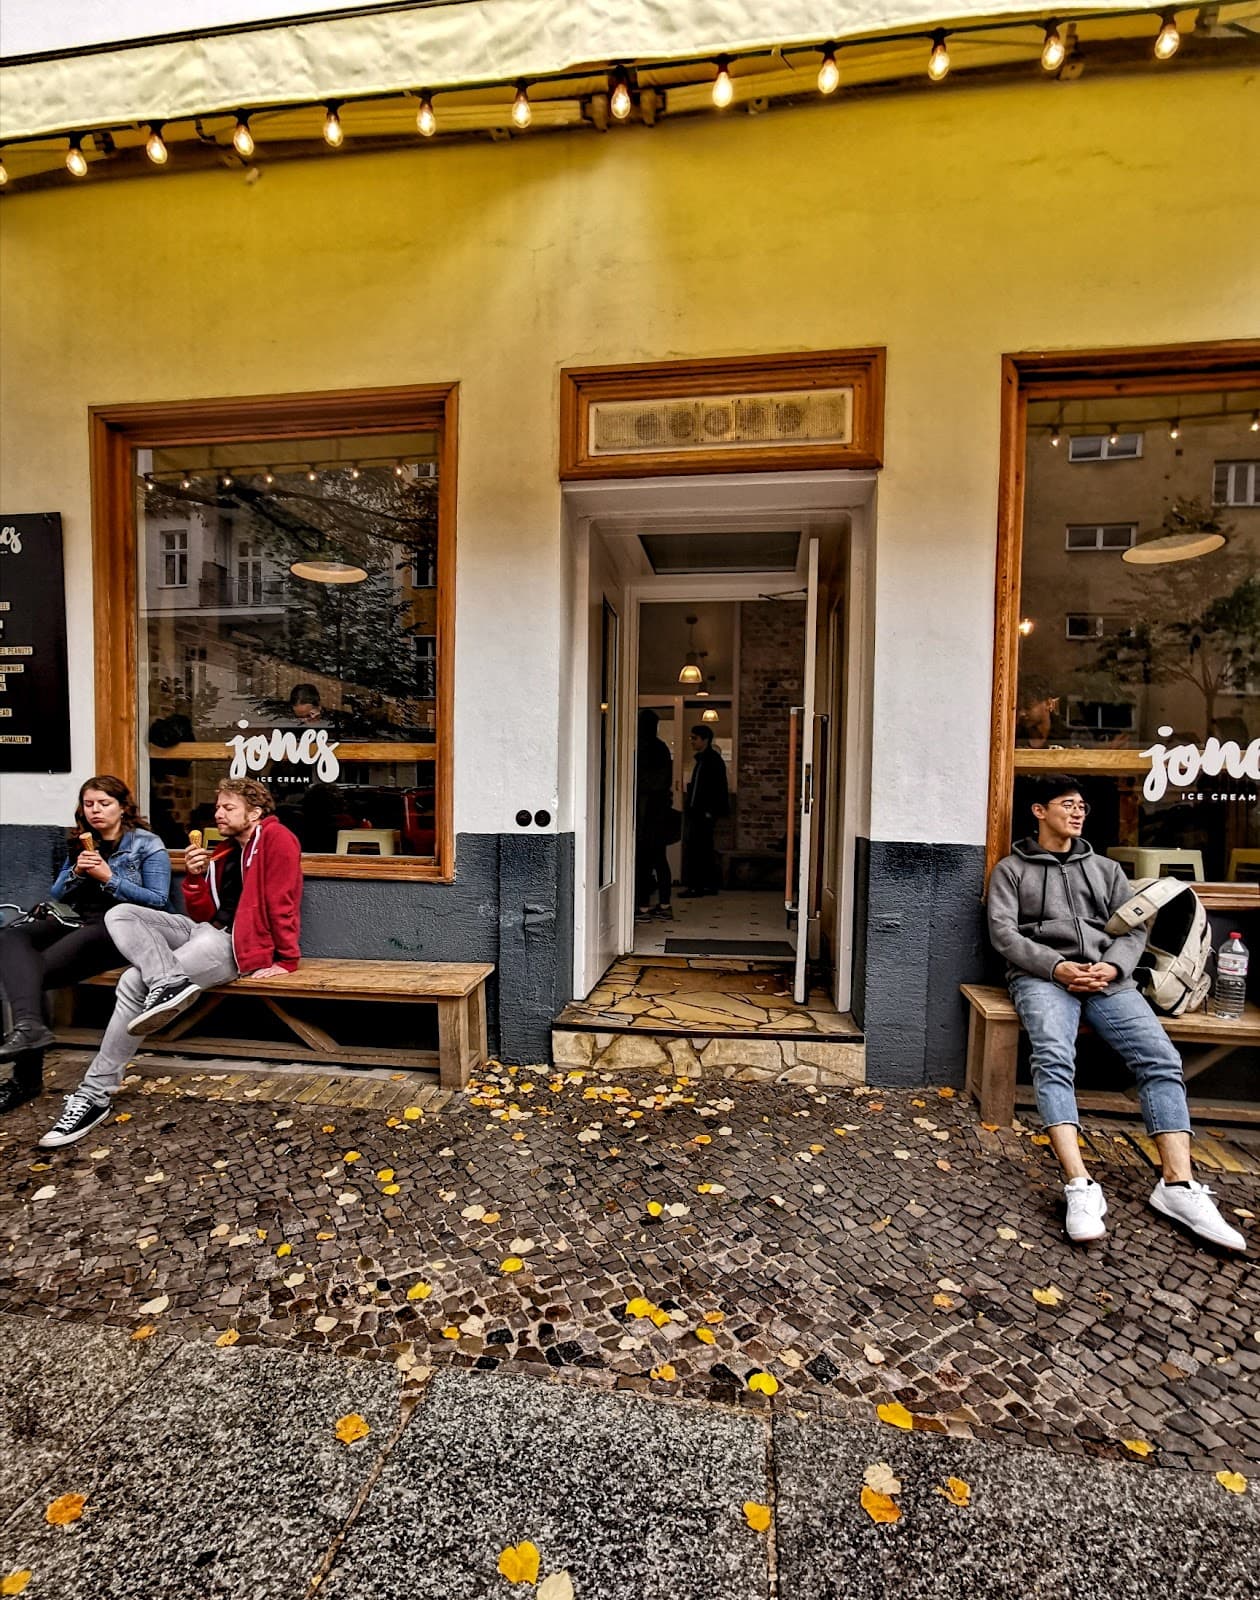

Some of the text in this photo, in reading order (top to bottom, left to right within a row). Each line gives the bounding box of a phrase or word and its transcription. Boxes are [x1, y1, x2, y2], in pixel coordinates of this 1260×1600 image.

[225, 719, 340, 783] jones
[1181, 792, 1257, 802] ICE CREAM
